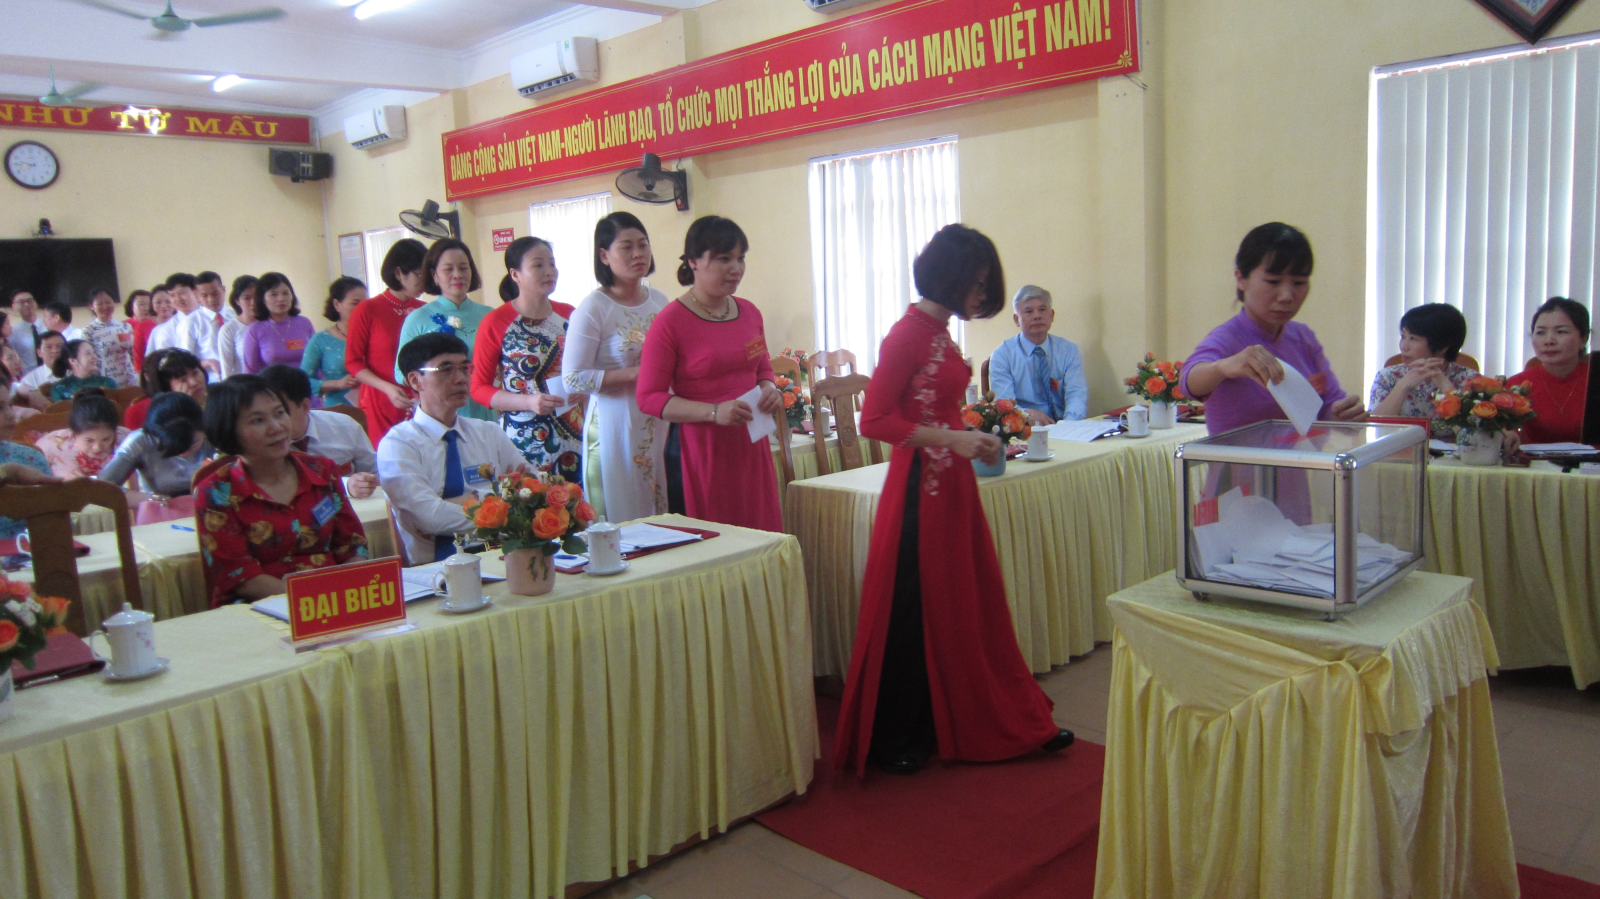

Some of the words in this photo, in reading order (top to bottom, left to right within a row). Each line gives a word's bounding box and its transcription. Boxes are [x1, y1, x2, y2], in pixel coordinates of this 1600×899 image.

[450, 145, 473, 182] ĐẢNG
[473, 142, 497, 182] CỘNG
[497, 132, 517, 172] SẢN
[517, 130, 537, 172] VIỆT
[597, 110, 627, 150] LÃNH
[628, 106, 657, 149] ĐẠO,
[658, 86, 675, 136] TỔ
[677, 86, 712, 132] CHỨC
[714, 83, 743, 129] MỌI
[745, 61, 796, 117] THẮNG
[798, 59, 825, 112] LỢI
[828, 42, 865, 99] CỦA
[867, 36, 918, 91] CÁCH
[922, 22, 986, 84] MẠNG
[989, 2, 1037, 69] VIỆT
[1044, 0, 1111, 52] NAM!
[184, 115, 279, 138] MẪU
[299, 591, 339, 624] ĐẠI
[344, 573, 396, 613] BIỂU
